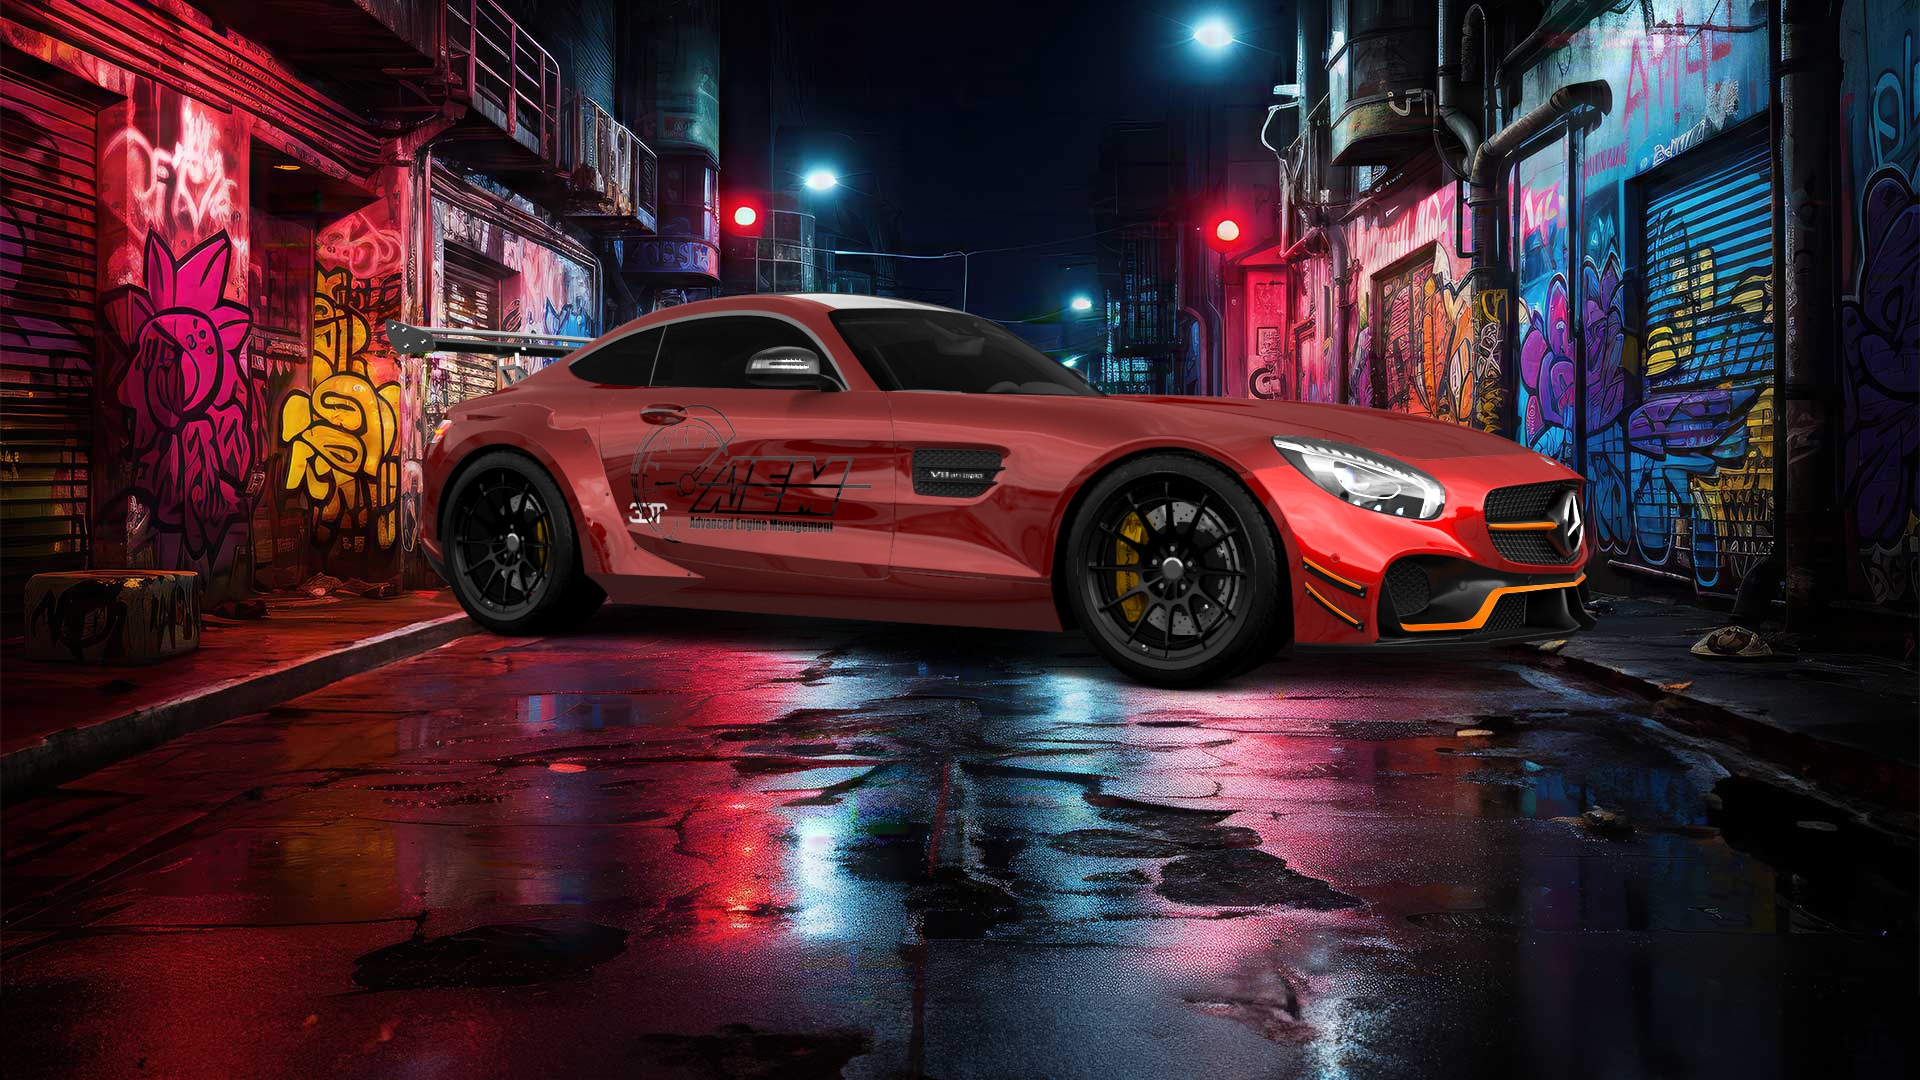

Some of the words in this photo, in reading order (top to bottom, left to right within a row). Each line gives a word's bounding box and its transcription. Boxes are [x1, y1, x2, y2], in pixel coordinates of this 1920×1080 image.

[930, 470, 950, 479] V8
[688, 456, 854, 517] AEM
[689, 515, 735, 531] Advanced
[735, 517, 768, 533] Engine
[769, 518, 835, 534] Management
